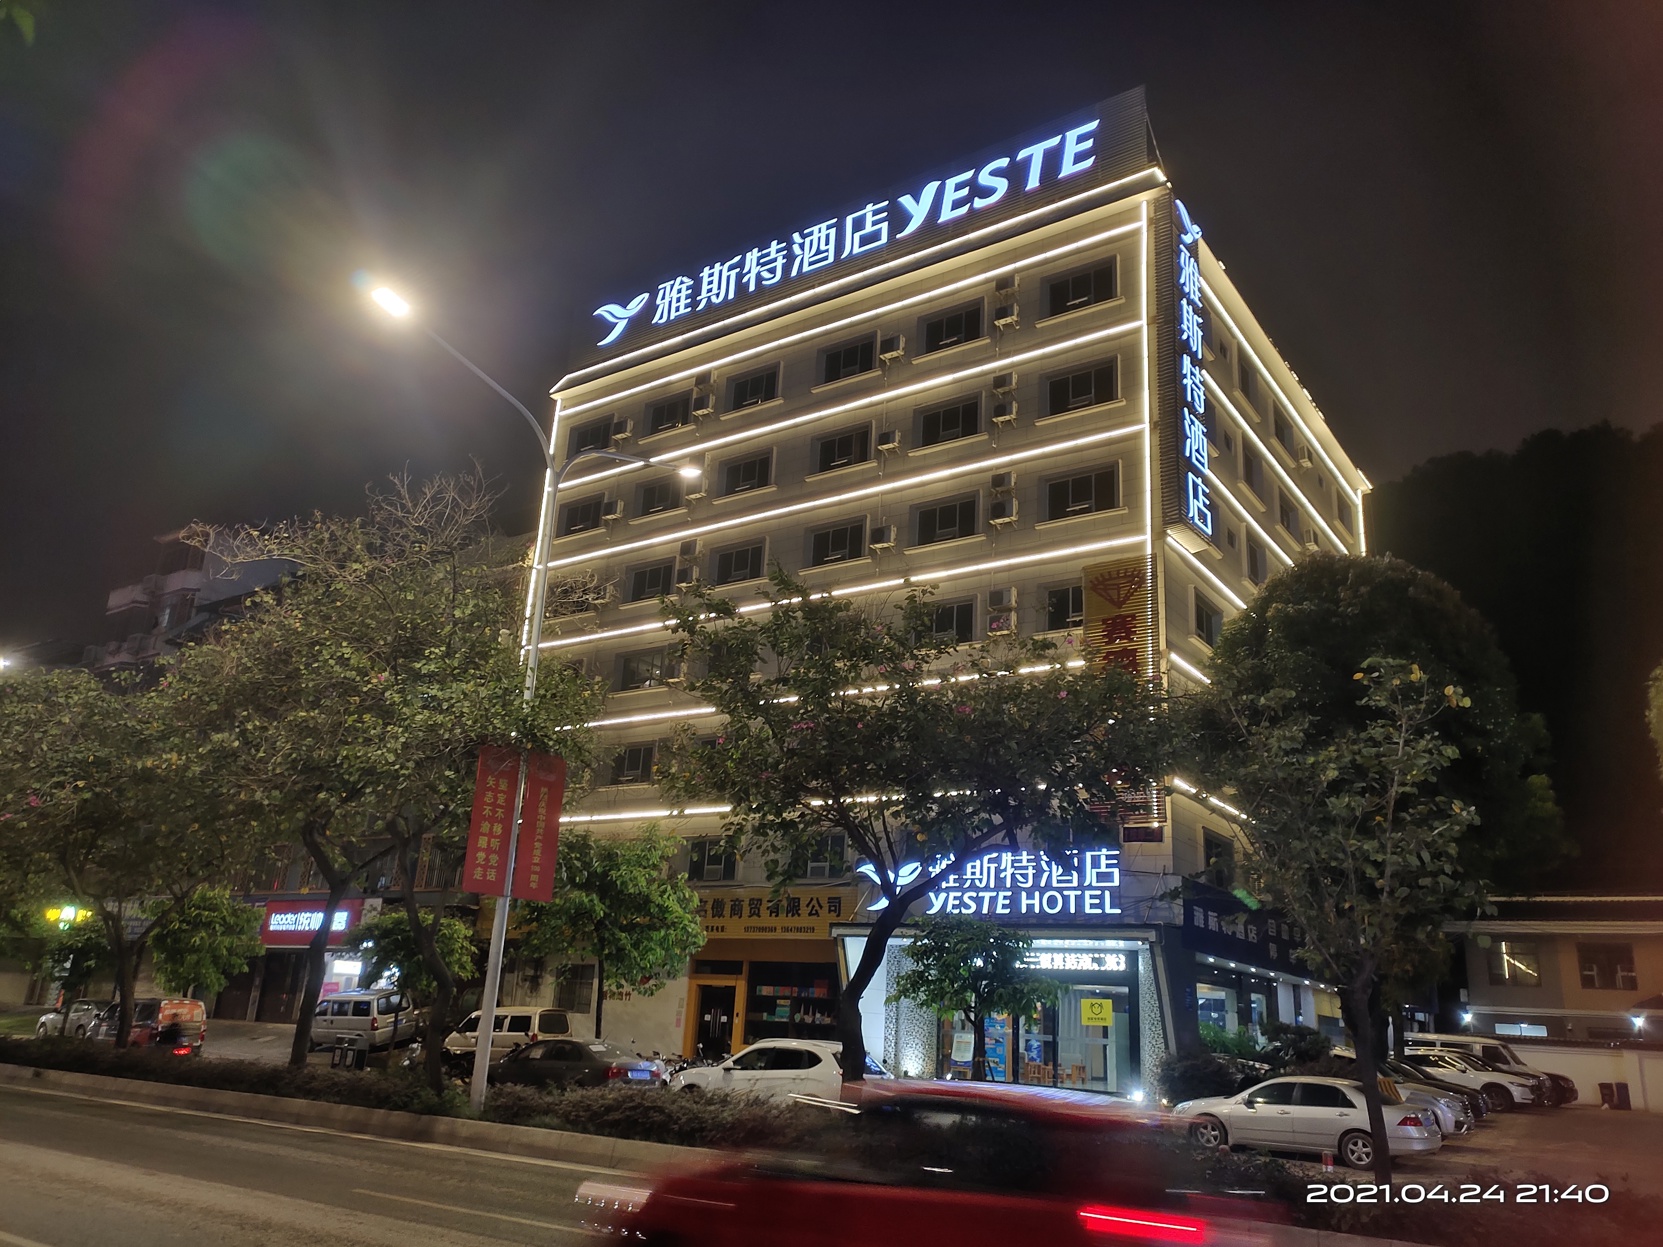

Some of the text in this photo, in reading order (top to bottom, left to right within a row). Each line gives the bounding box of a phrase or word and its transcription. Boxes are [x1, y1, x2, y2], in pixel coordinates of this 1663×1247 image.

[895, 118, 1100, 240] YESTE
[651, 200, 890, 326] 雅斯特酒店
[1177, 244, 1213, 537] 雅斯特酒店
[270, 912, 297, 925] Leader
[298, 911, 348, 931] 统帅器
[925, 889, 1122, 915] YESTE HOTEL
